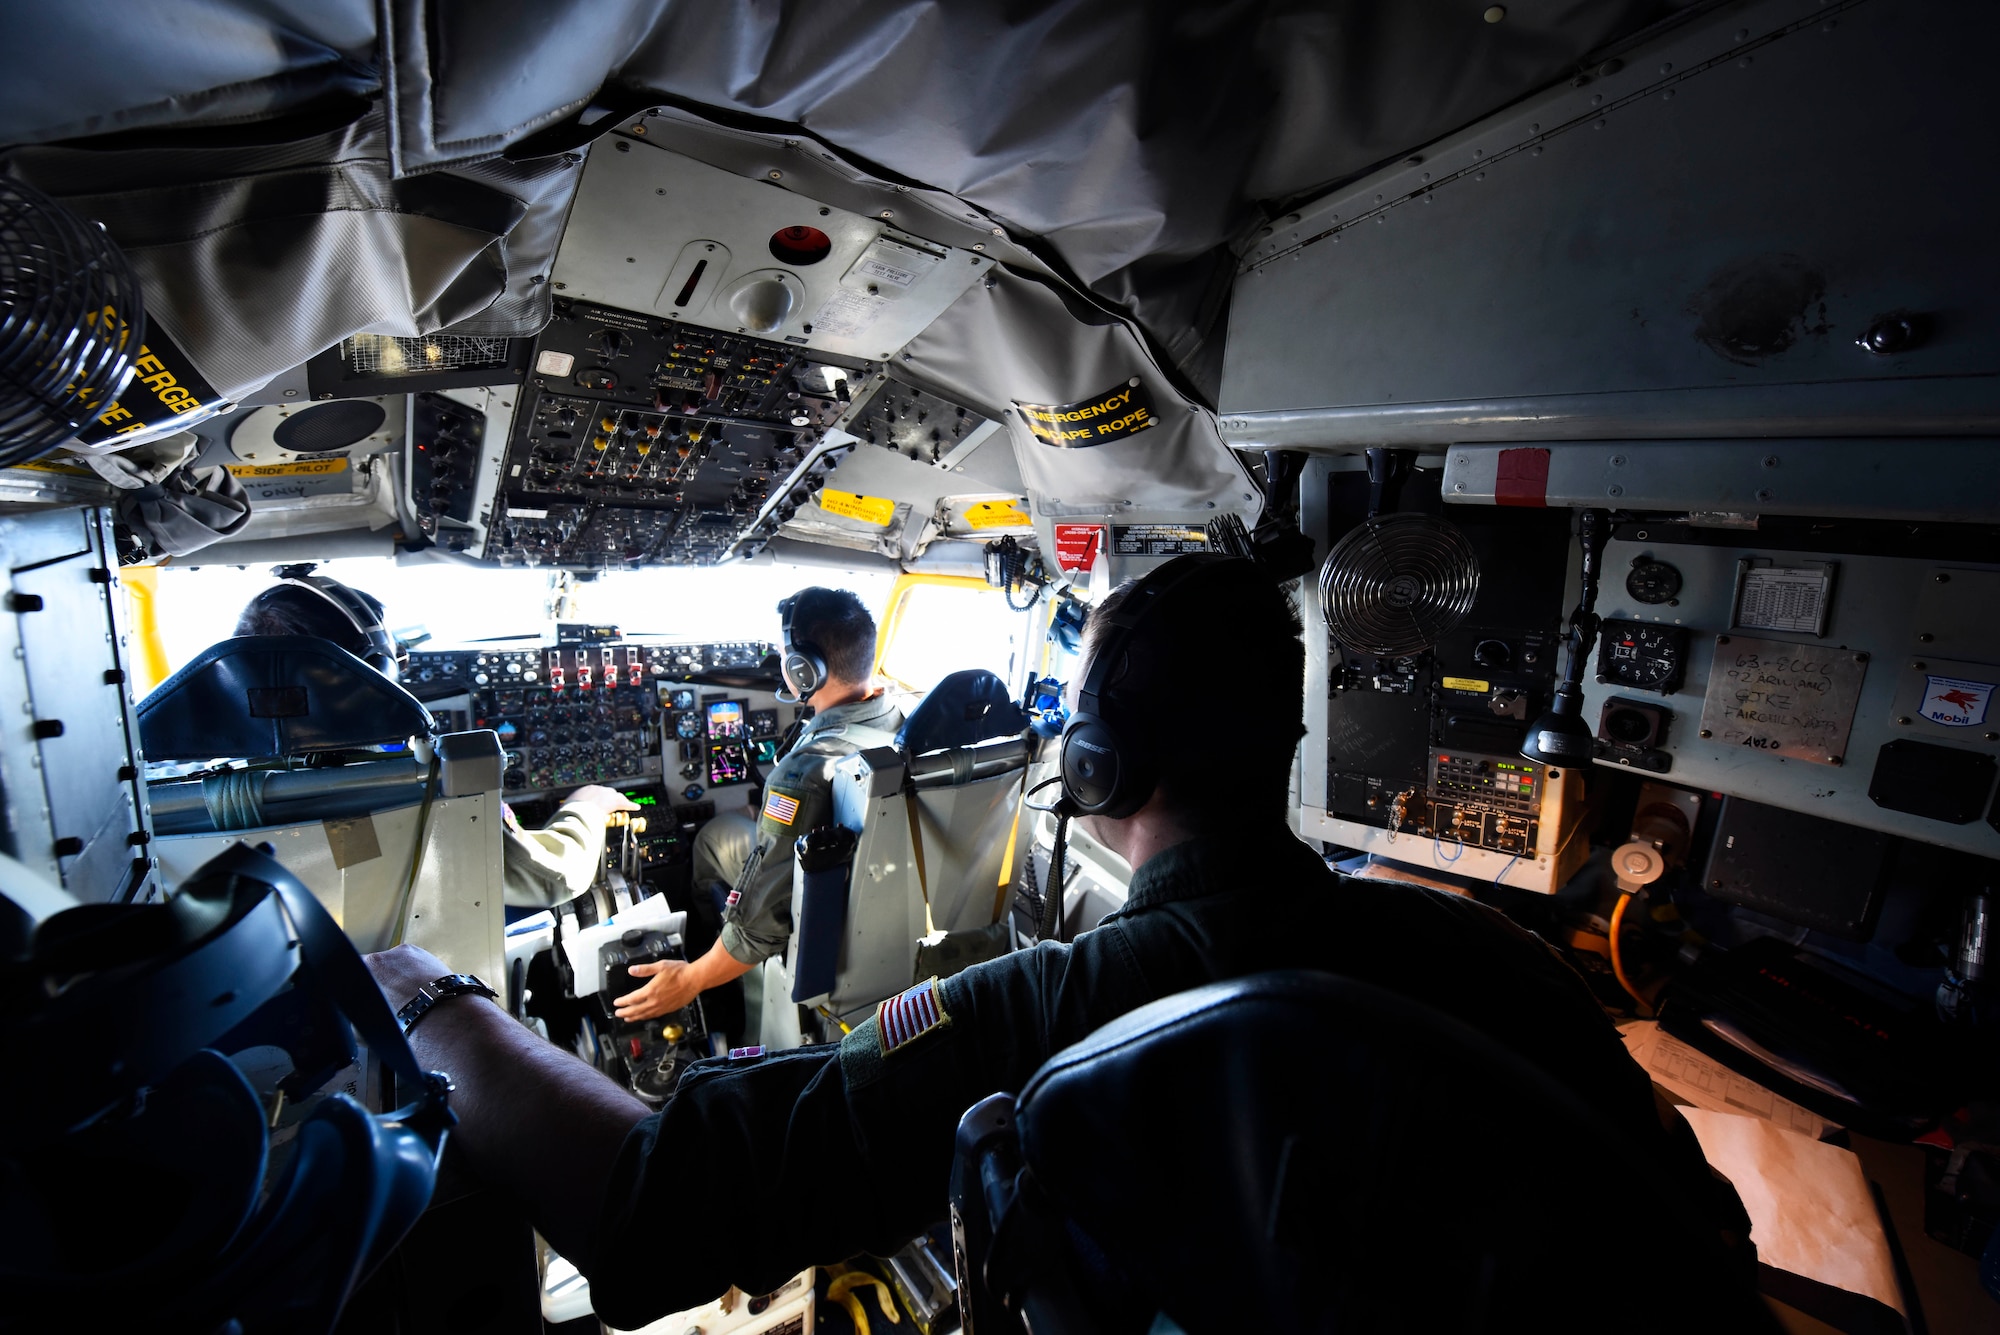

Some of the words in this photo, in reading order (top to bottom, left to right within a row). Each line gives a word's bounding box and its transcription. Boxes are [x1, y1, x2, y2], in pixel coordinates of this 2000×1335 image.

[872, 263, 885, 271] CABIN
[886, 268, 908, 279] PRESSURE
[886, 273, 900, 281] VALVE
[584, 315, 622, 326] TEMPERATURE
[623, 322, 648, 331] CONTROL
[603, 311, 648, 324] CONDITIONING
[1024, 389, 1130, 423] EMERGENCY
[1097, 408, 1149, 435] ROPE
[254, 467, 284, 476] SIDE
[294, 464, 332, 473] PILOT
[261, 487, 305, 498] ONLY
[838, 507, 852, 515] SIDE
[845, 503, 885, 518] WINDSHIELD
[1932, 712, 1970, 724] Mobil
[1074, 740, 1110, 754] BOSE
